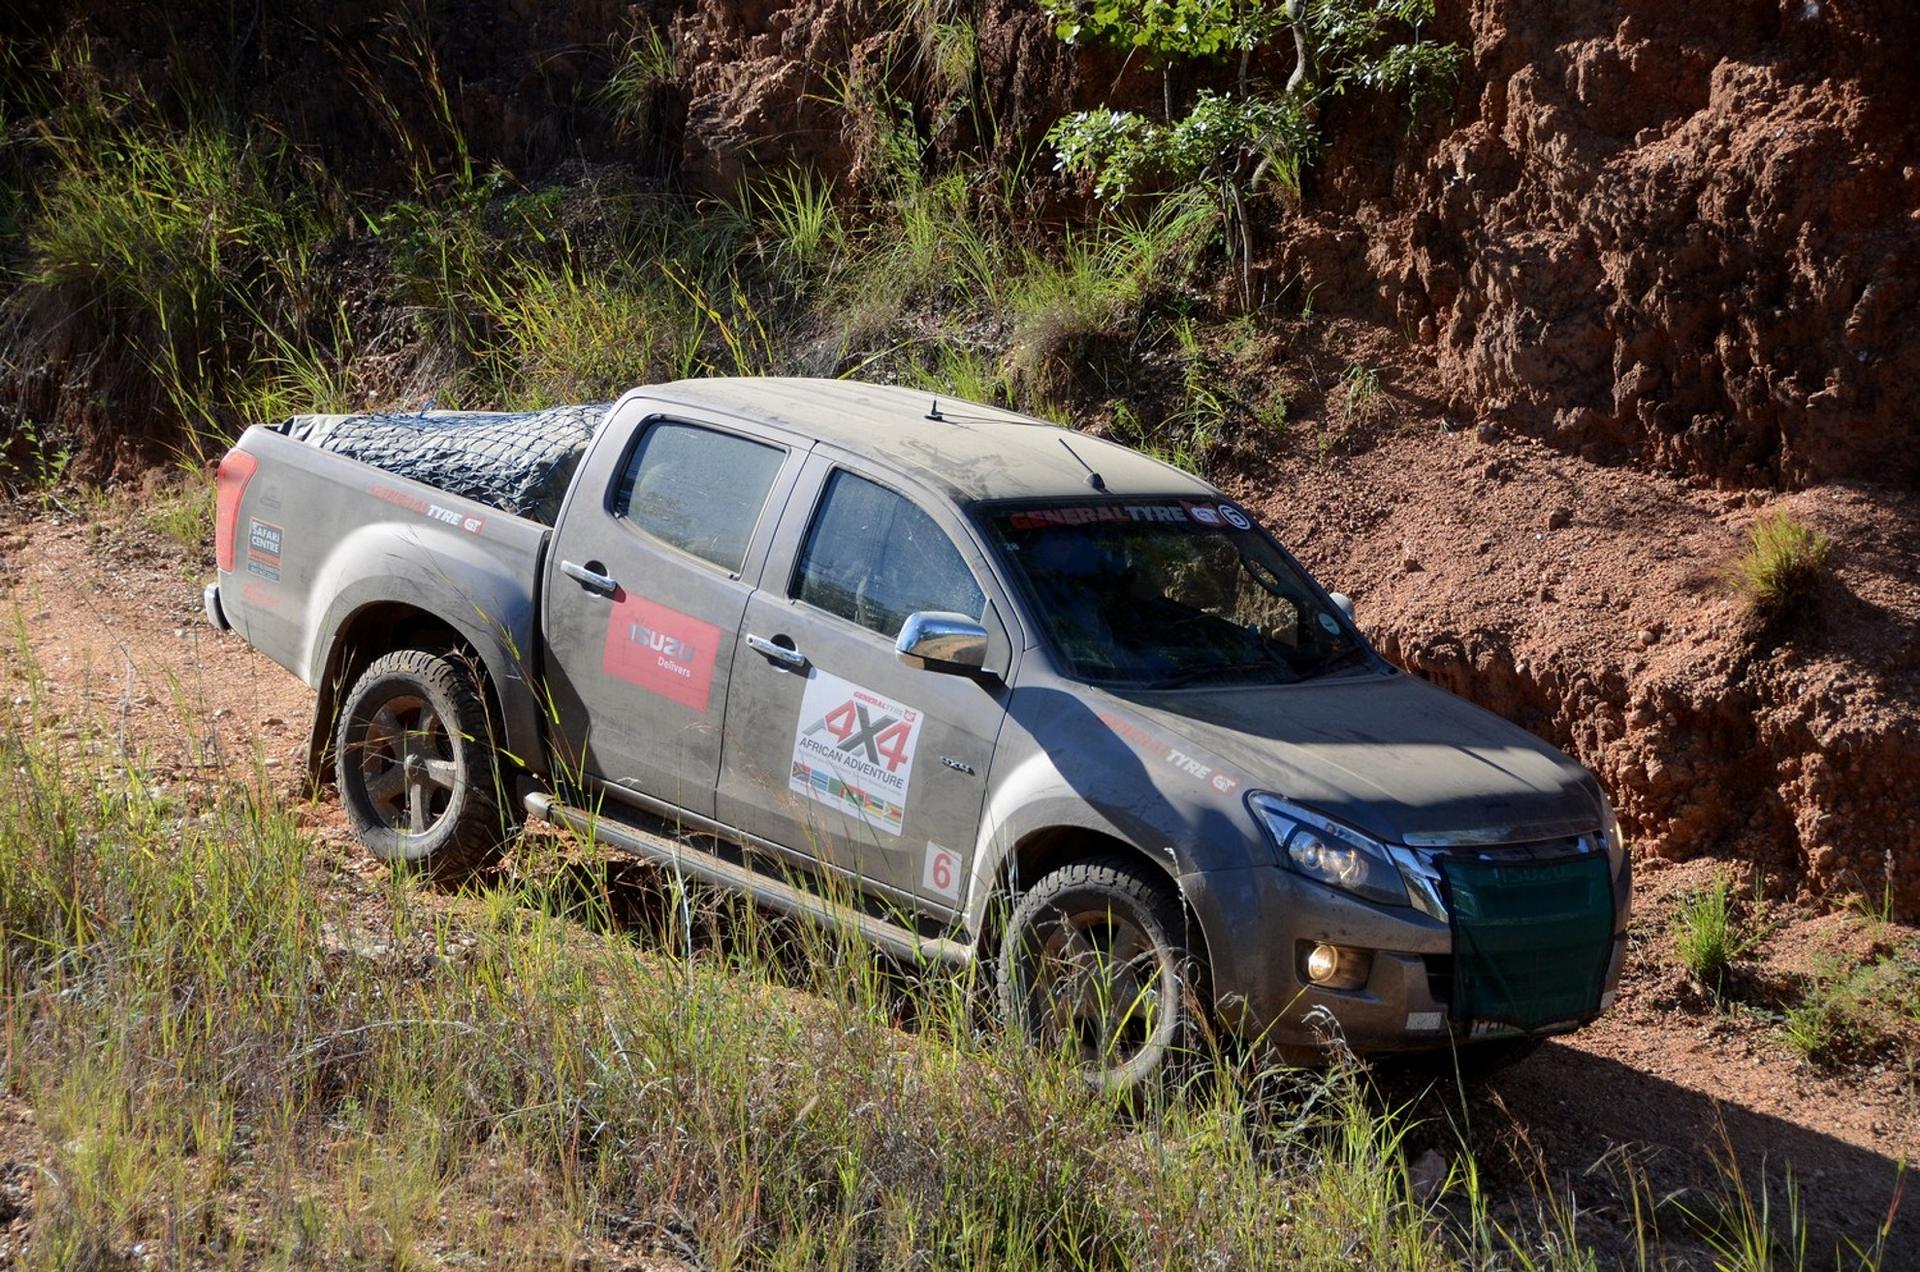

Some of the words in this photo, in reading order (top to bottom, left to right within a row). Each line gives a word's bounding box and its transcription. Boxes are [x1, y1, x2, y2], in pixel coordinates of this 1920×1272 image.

[427, 504, 463, 526] TYRE
[1124, 505, 1188, 522] TYRE
[252, 521, 280, 542] SAFARI
[251, 535, 279, 553] CENTRE
[629, 624, 696, 664] ISUZU
[657, 656, 691, 678] Delivers
[800, 737, 842, 764] AFRICAN
[843, 755, 905, 790] ADVENTURE
[1165, 749, 1212, 780] TYRE
[932, 852, 952, 890] 6
